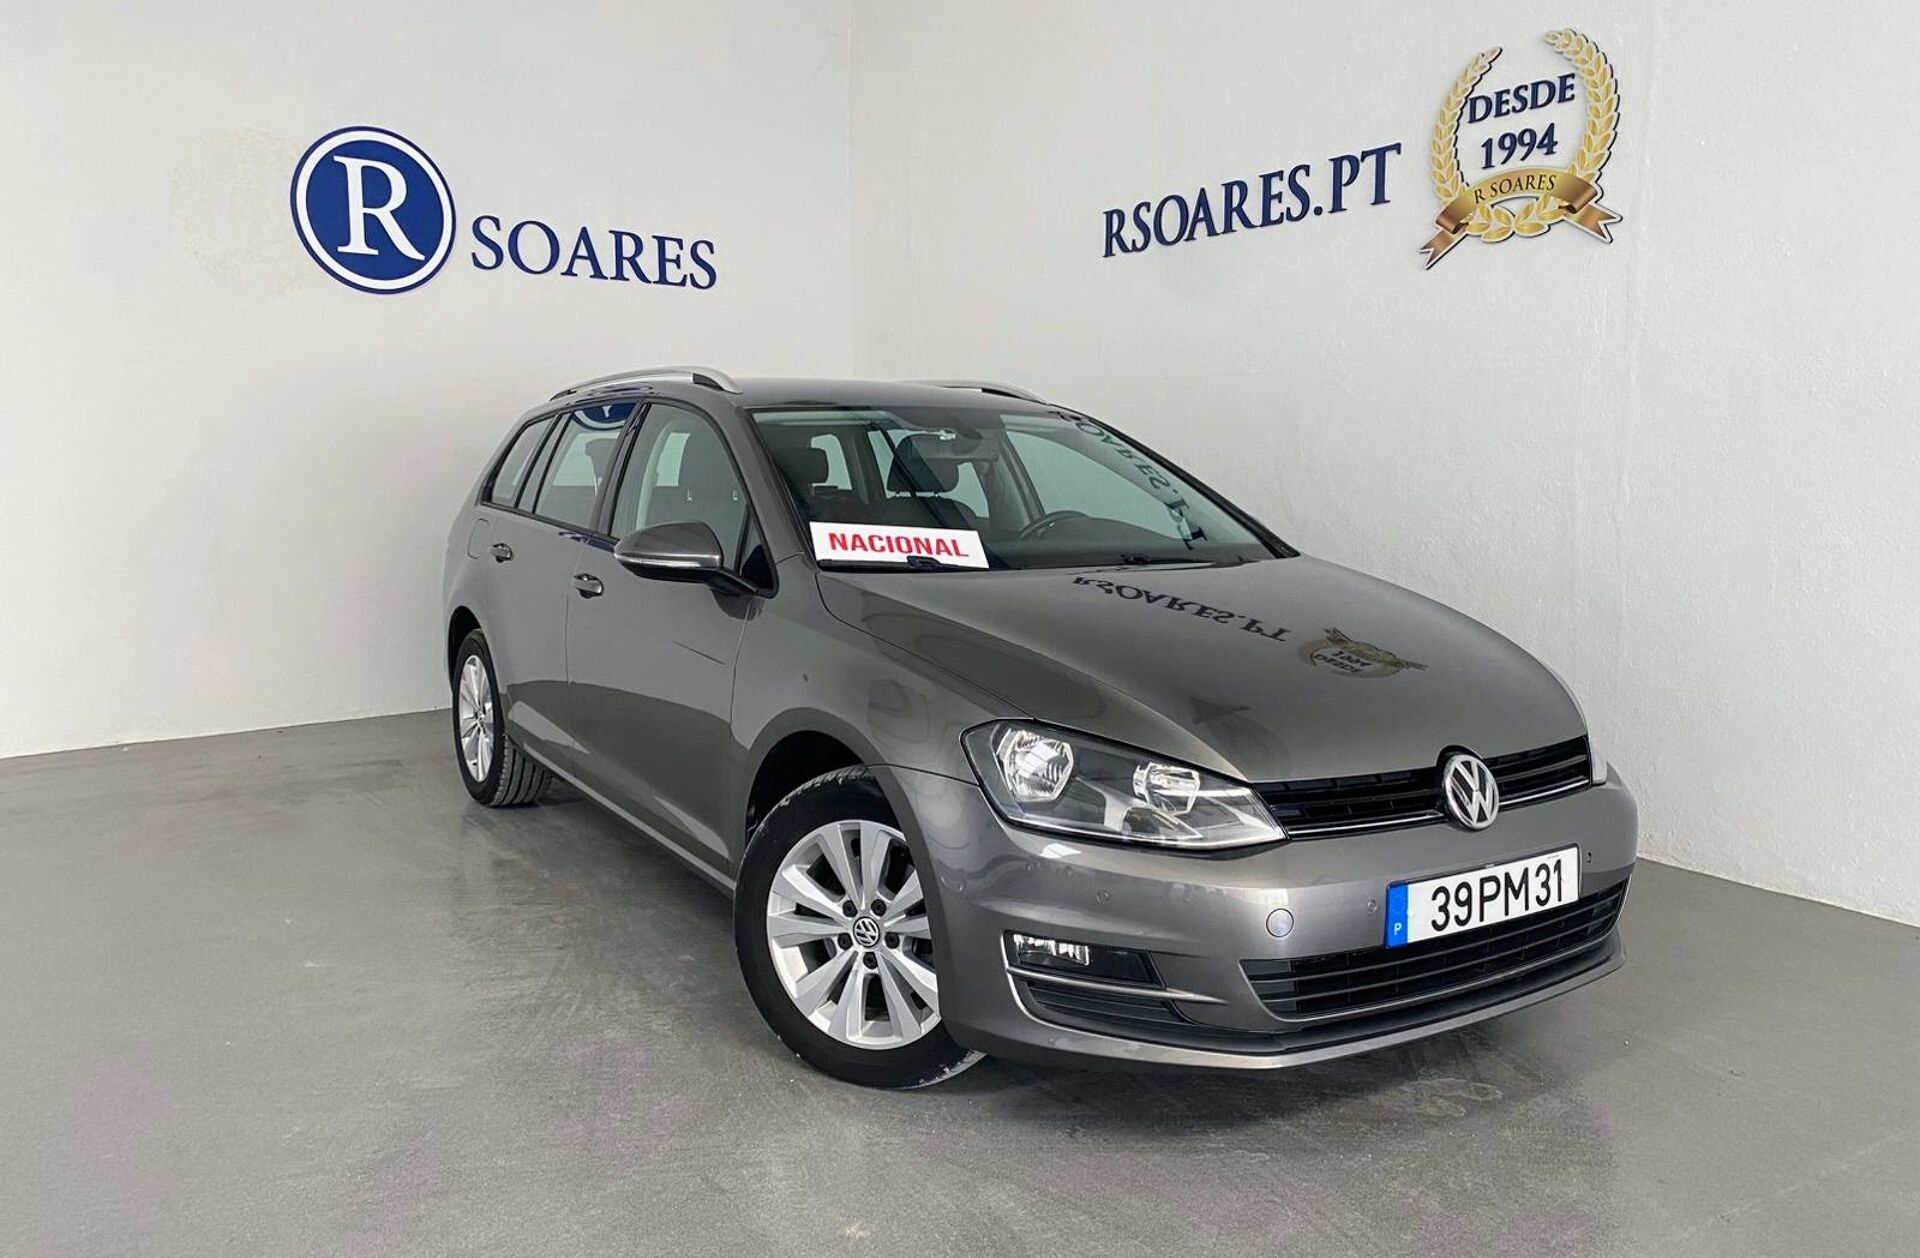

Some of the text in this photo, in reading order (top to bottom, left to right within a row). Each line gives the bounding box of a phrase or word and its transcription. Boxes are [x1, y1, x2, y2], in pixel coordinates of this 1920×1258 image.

[1467, 73, 1575, 124] DESDE
[1481, 122, 1558, 169] 1994
[1102, 142, 1402, 258] RSOARES.PT
[1474, 174, 1557, 204] R SOARES
[332, 155, 718, 290] R SOARES
[828, 532, 969, 557] NACIONAL
[1393, 859, 1562, 936] P 39PM31
